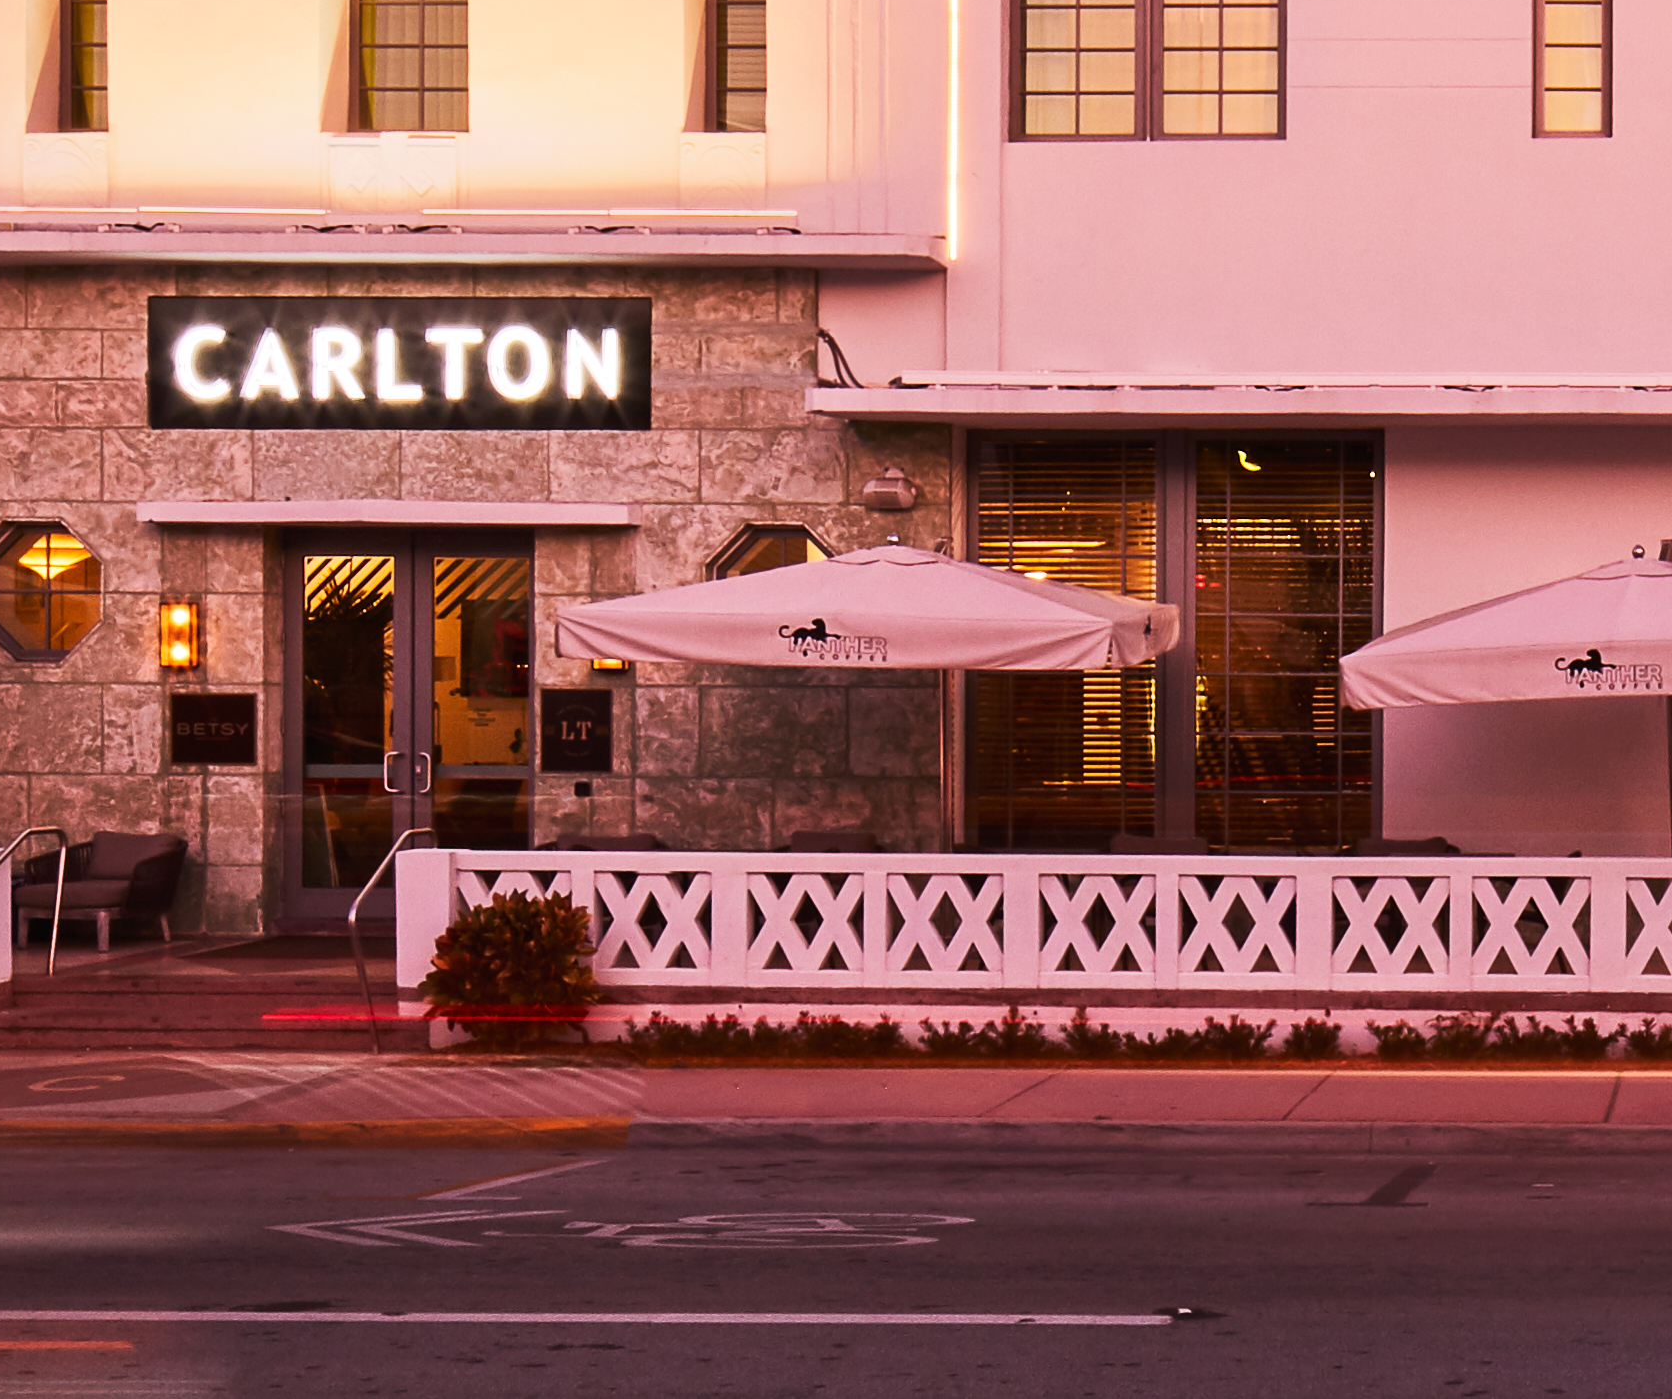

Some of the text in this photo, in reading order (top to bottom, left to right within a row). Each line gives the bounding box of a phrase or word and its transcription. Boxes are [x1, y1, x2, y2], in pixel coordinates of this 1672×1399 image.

[173, 323, 621, 402] CARLTON
[177, 722, 248, 735] BETSY
[561, 721, 592, 740] LT
